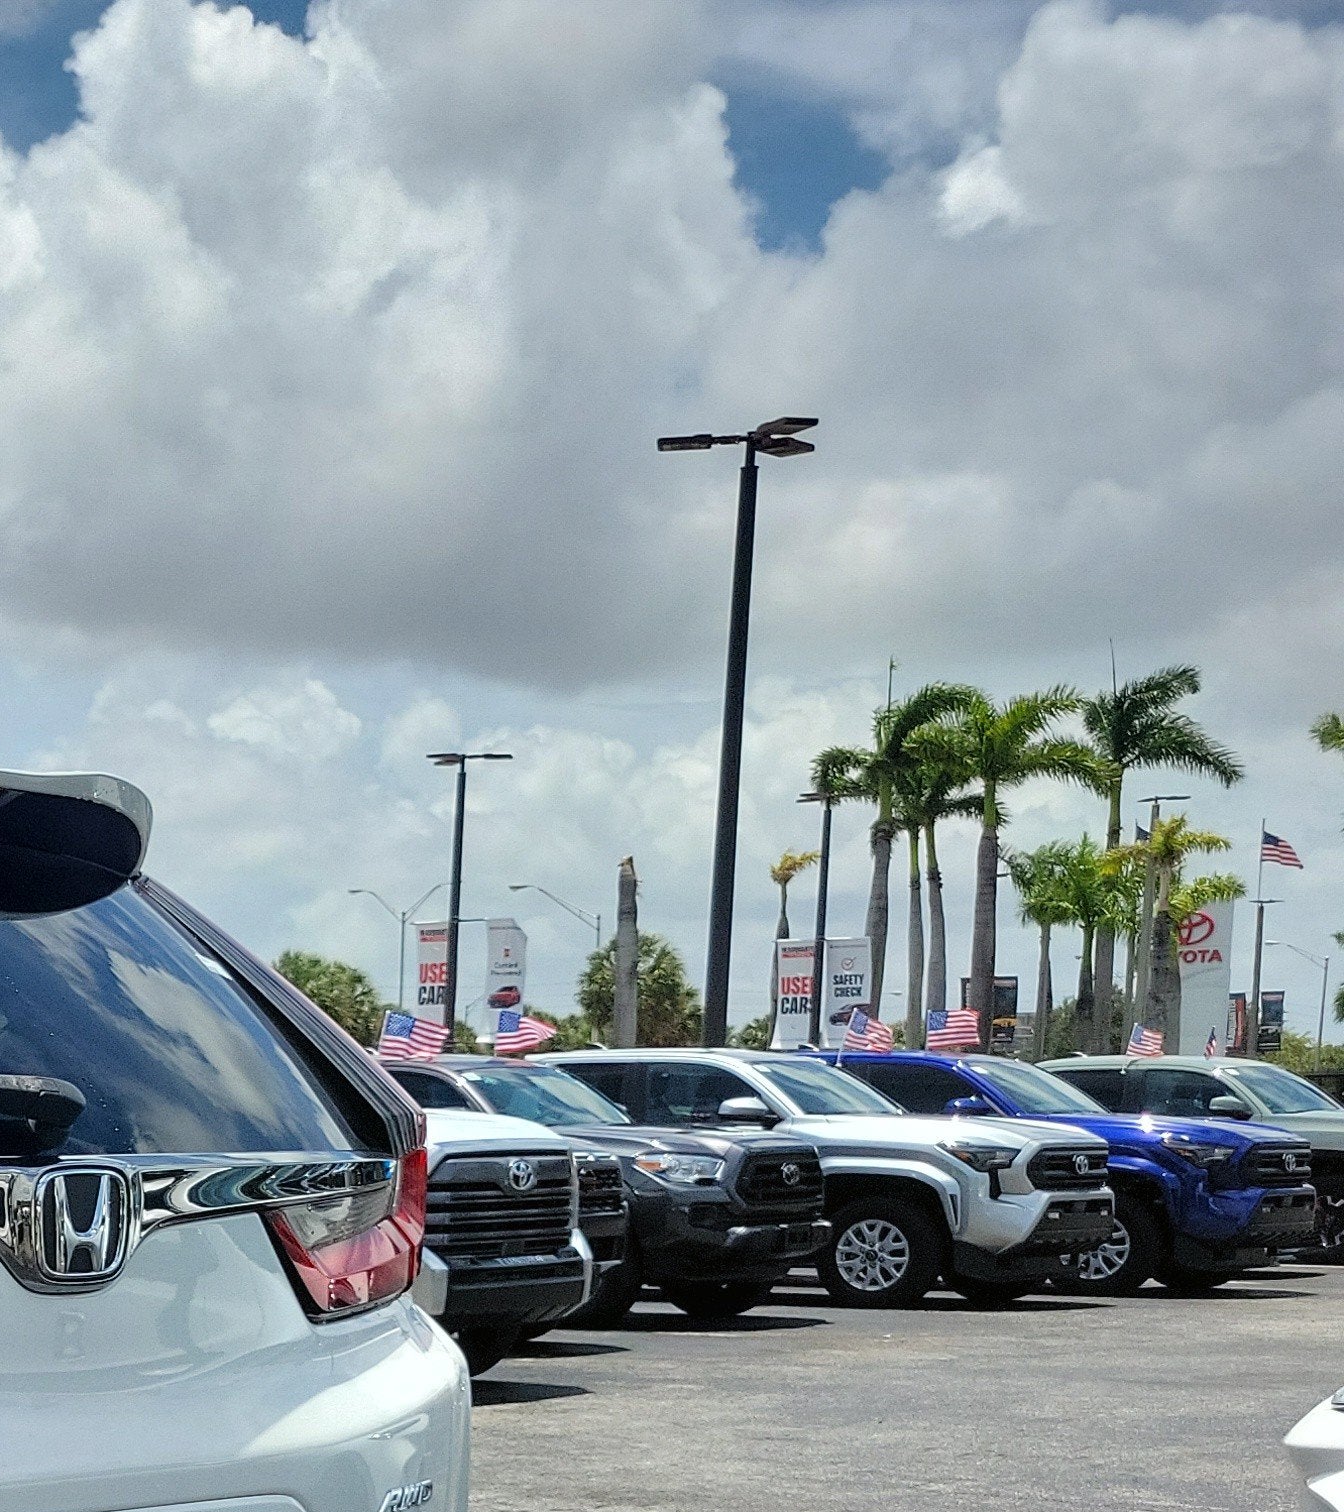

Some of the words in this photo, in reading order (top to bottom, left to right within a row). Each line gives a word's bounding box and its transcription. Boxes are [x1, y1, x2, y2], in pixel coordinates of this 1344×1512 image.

[1179, 949, 1222, 963] OTA
[419, 962, 448, 983] USE
[833, 974, 864, 985] SAFETY
[781, 976, 814, 995] USE
[834, 987, 862, 998] CHECK
[418, 985, 446, 1005] CAR
